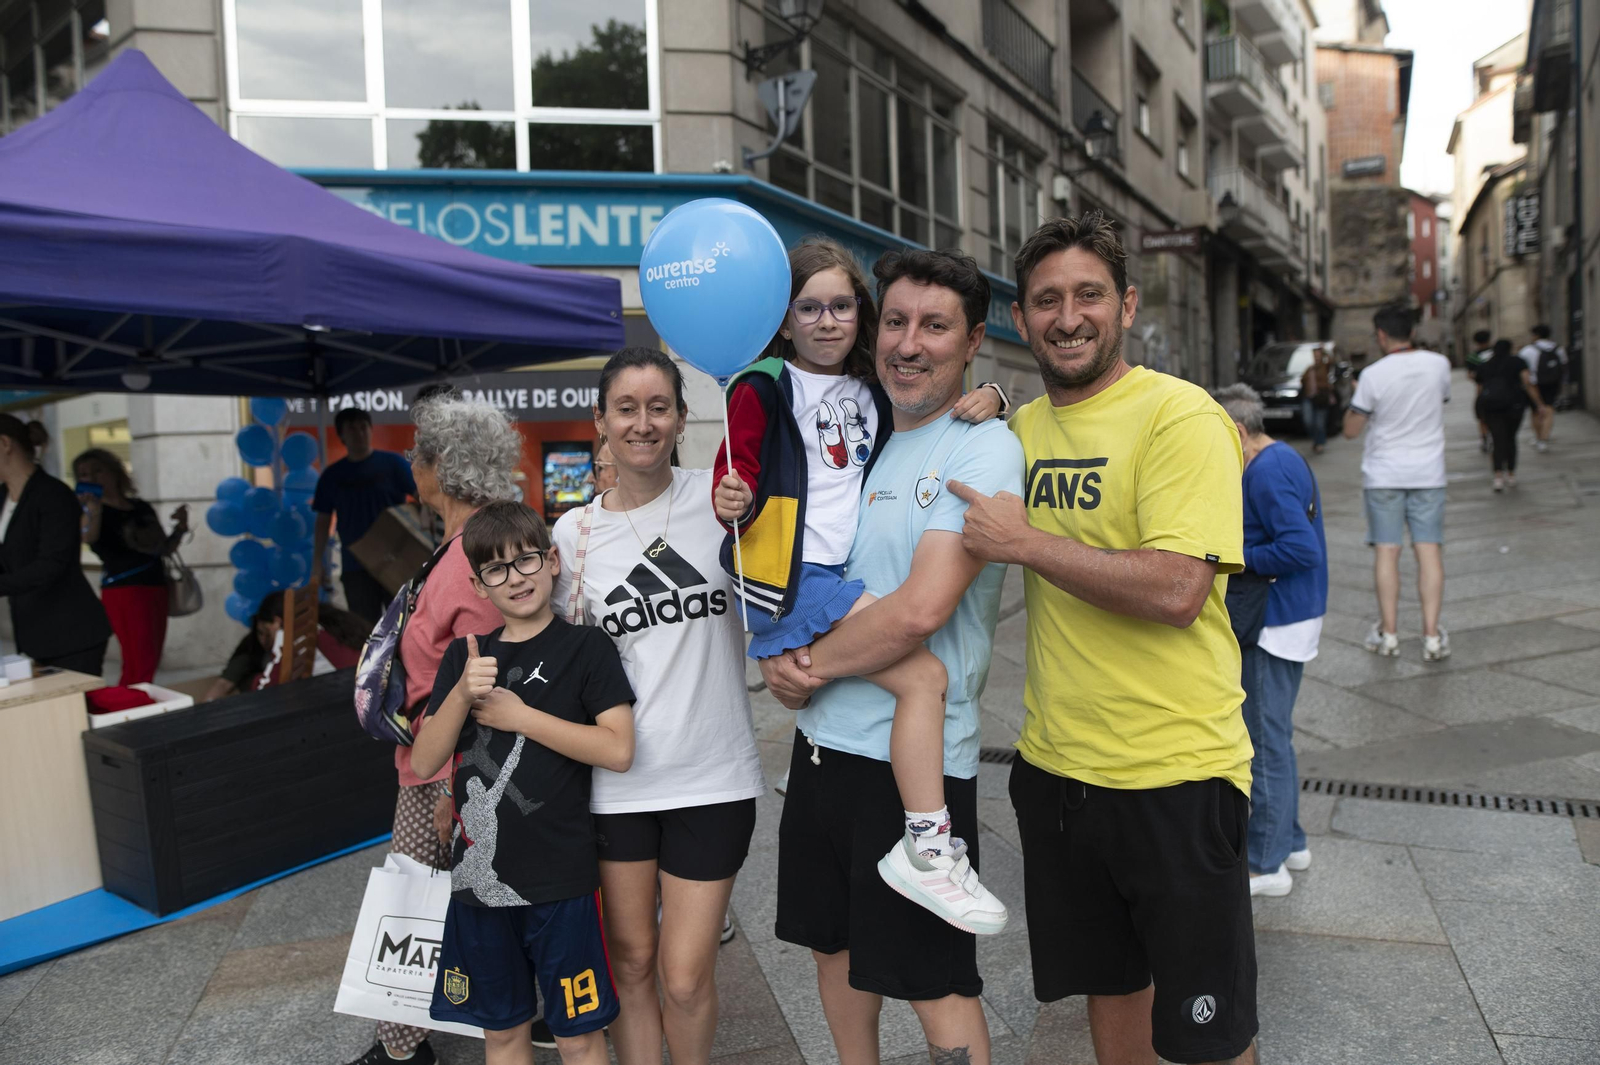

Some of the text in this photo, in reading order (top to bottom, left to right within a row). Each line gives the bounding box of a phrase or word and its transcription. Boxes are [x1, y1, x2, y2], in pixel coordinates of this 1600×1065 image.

[646, 258, 717, 282] ourense
[664, 276, 700, 290] centro
[532, 388, 557, 408] DE
[602, 588, 728, 638] adidas
[376, 965, 423, 977] ZAPATERIA
[559, 968, 600, 1020] 19
